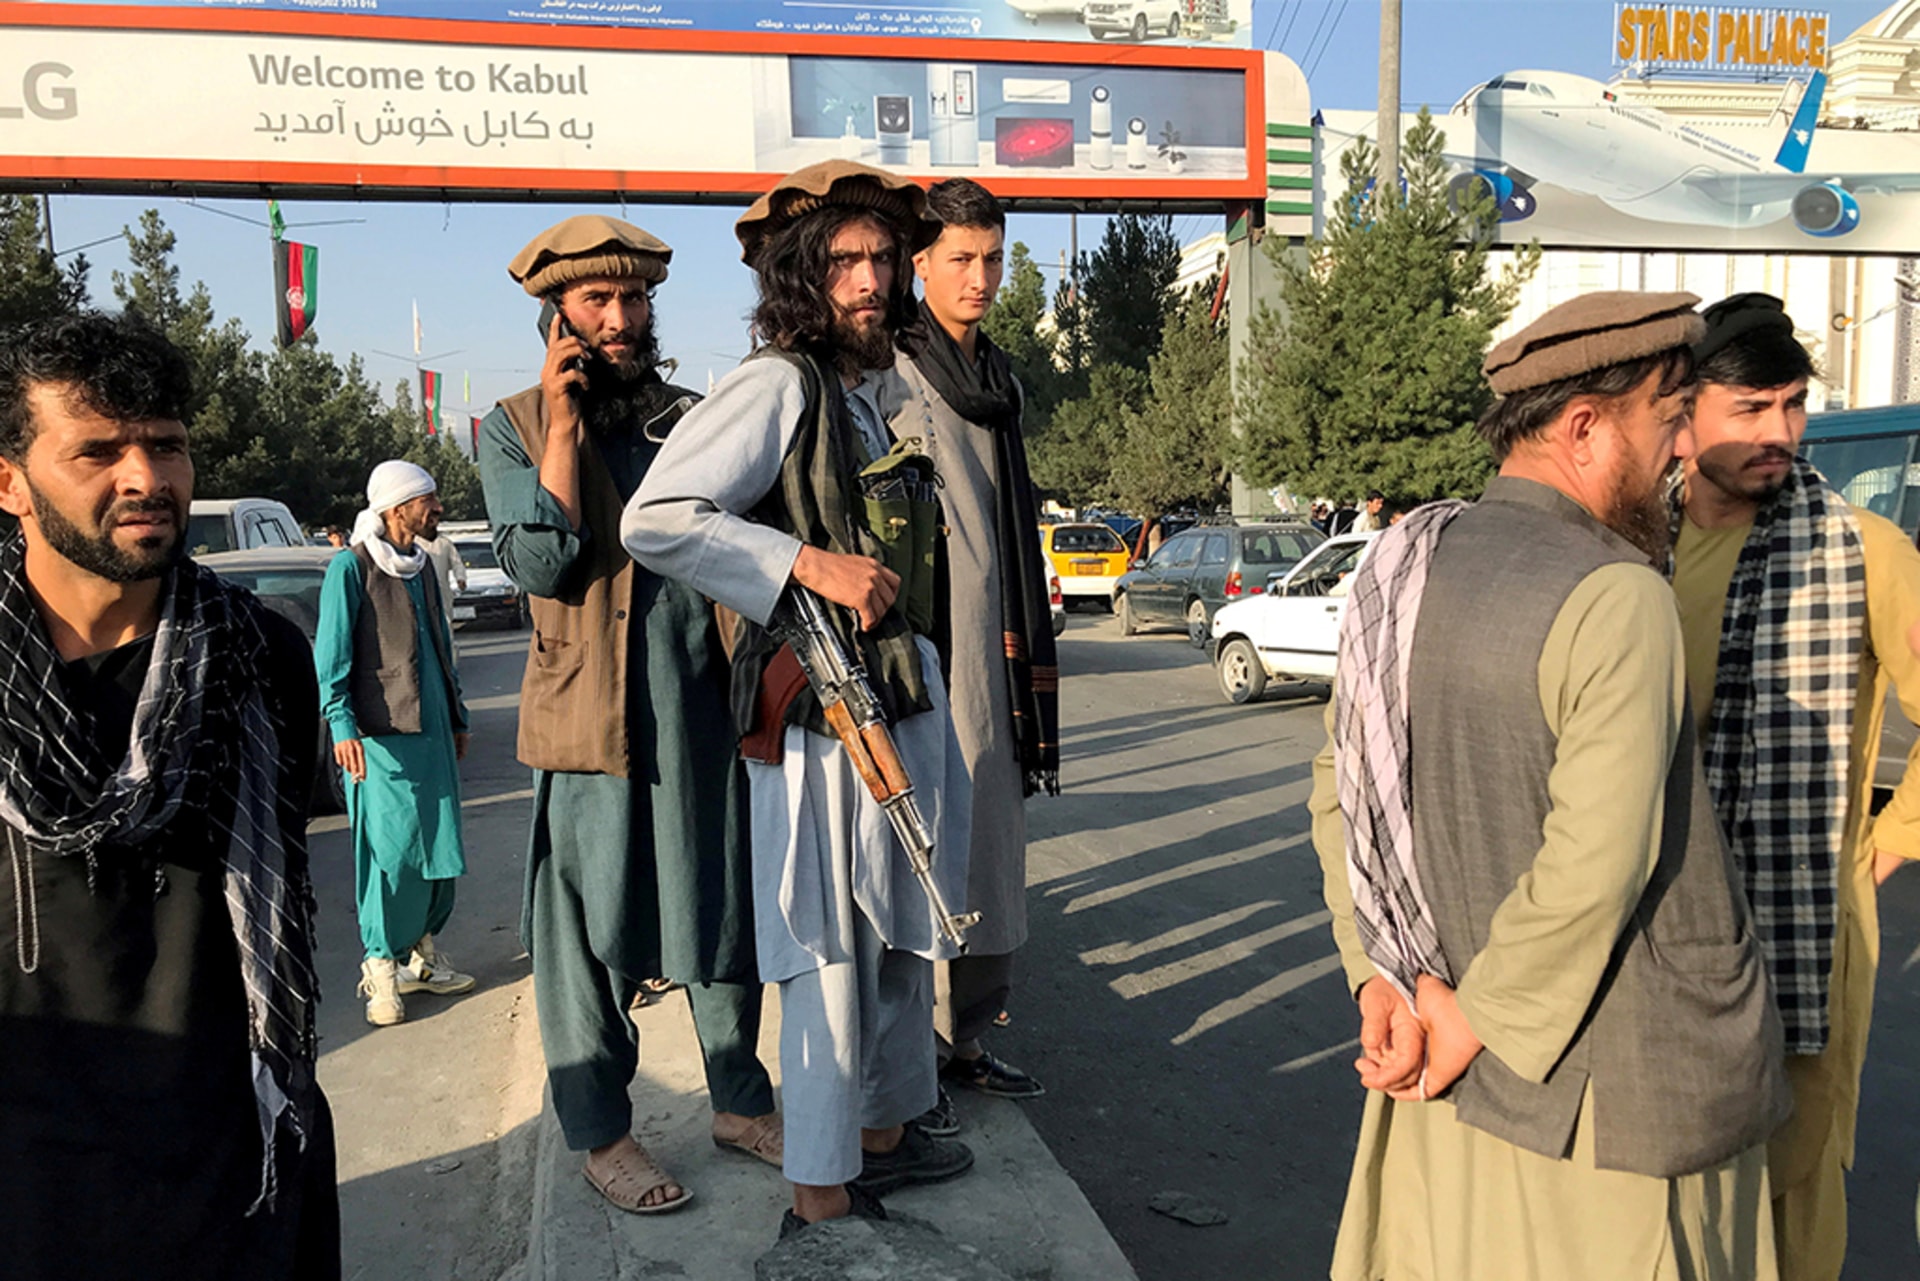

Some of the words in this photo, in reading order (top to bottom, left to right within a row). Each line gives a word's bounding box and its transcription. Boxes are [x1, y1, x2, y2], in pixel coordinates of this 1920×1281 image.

[1617, 8, 1710, 62] STARS
[1716, 13, 1827, 68] PALACE
[248, 53, 424, 90] Welcome
[435, 66, 475, 92] to
[488, 63, 588, 95] Kabul
[254, 99, 345, 142] آمدید
[355, 100, 454, 145] خوش
[464, 110, 550, 147] کابل
[559, 118, 593, 149] به
